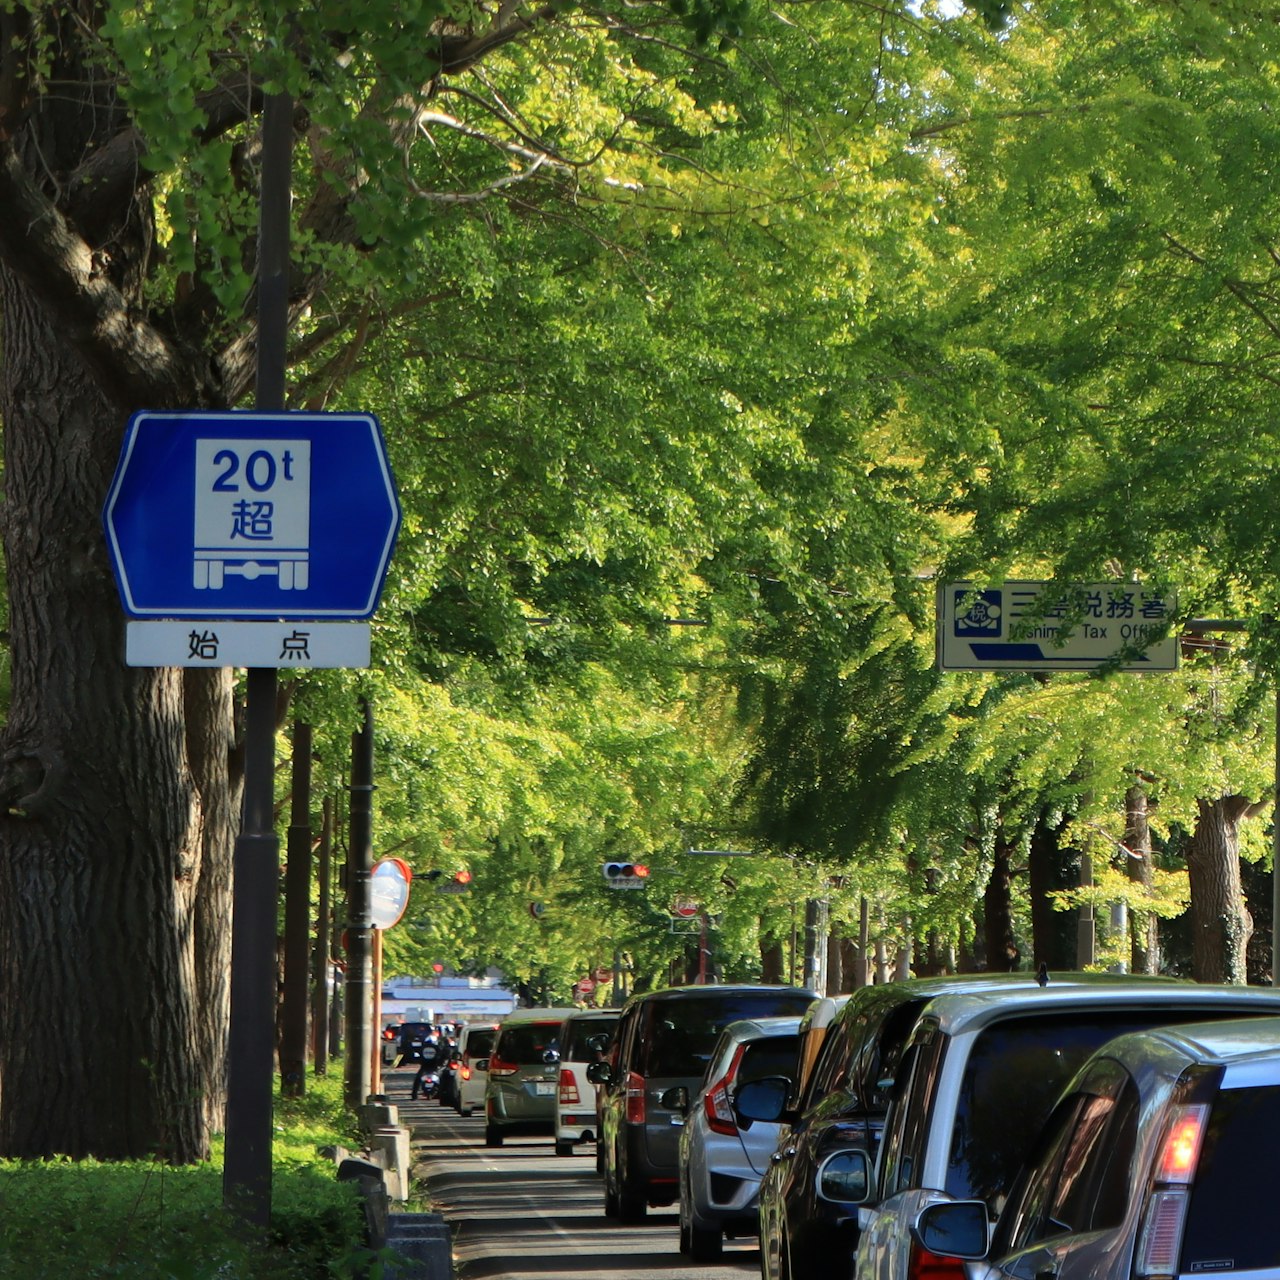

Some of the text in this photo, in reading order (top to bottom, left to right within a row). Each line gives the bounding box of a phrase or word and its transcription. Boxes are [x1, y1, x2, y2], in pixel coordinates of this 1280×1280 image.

[212, 449, 294, 492] 20t
[230, 499, 274, 540] 超
[970, 605, 986, 621] 税
[1082, 624, 1107, 638] Tax
[1120, 624, 1160, 639] Offi
